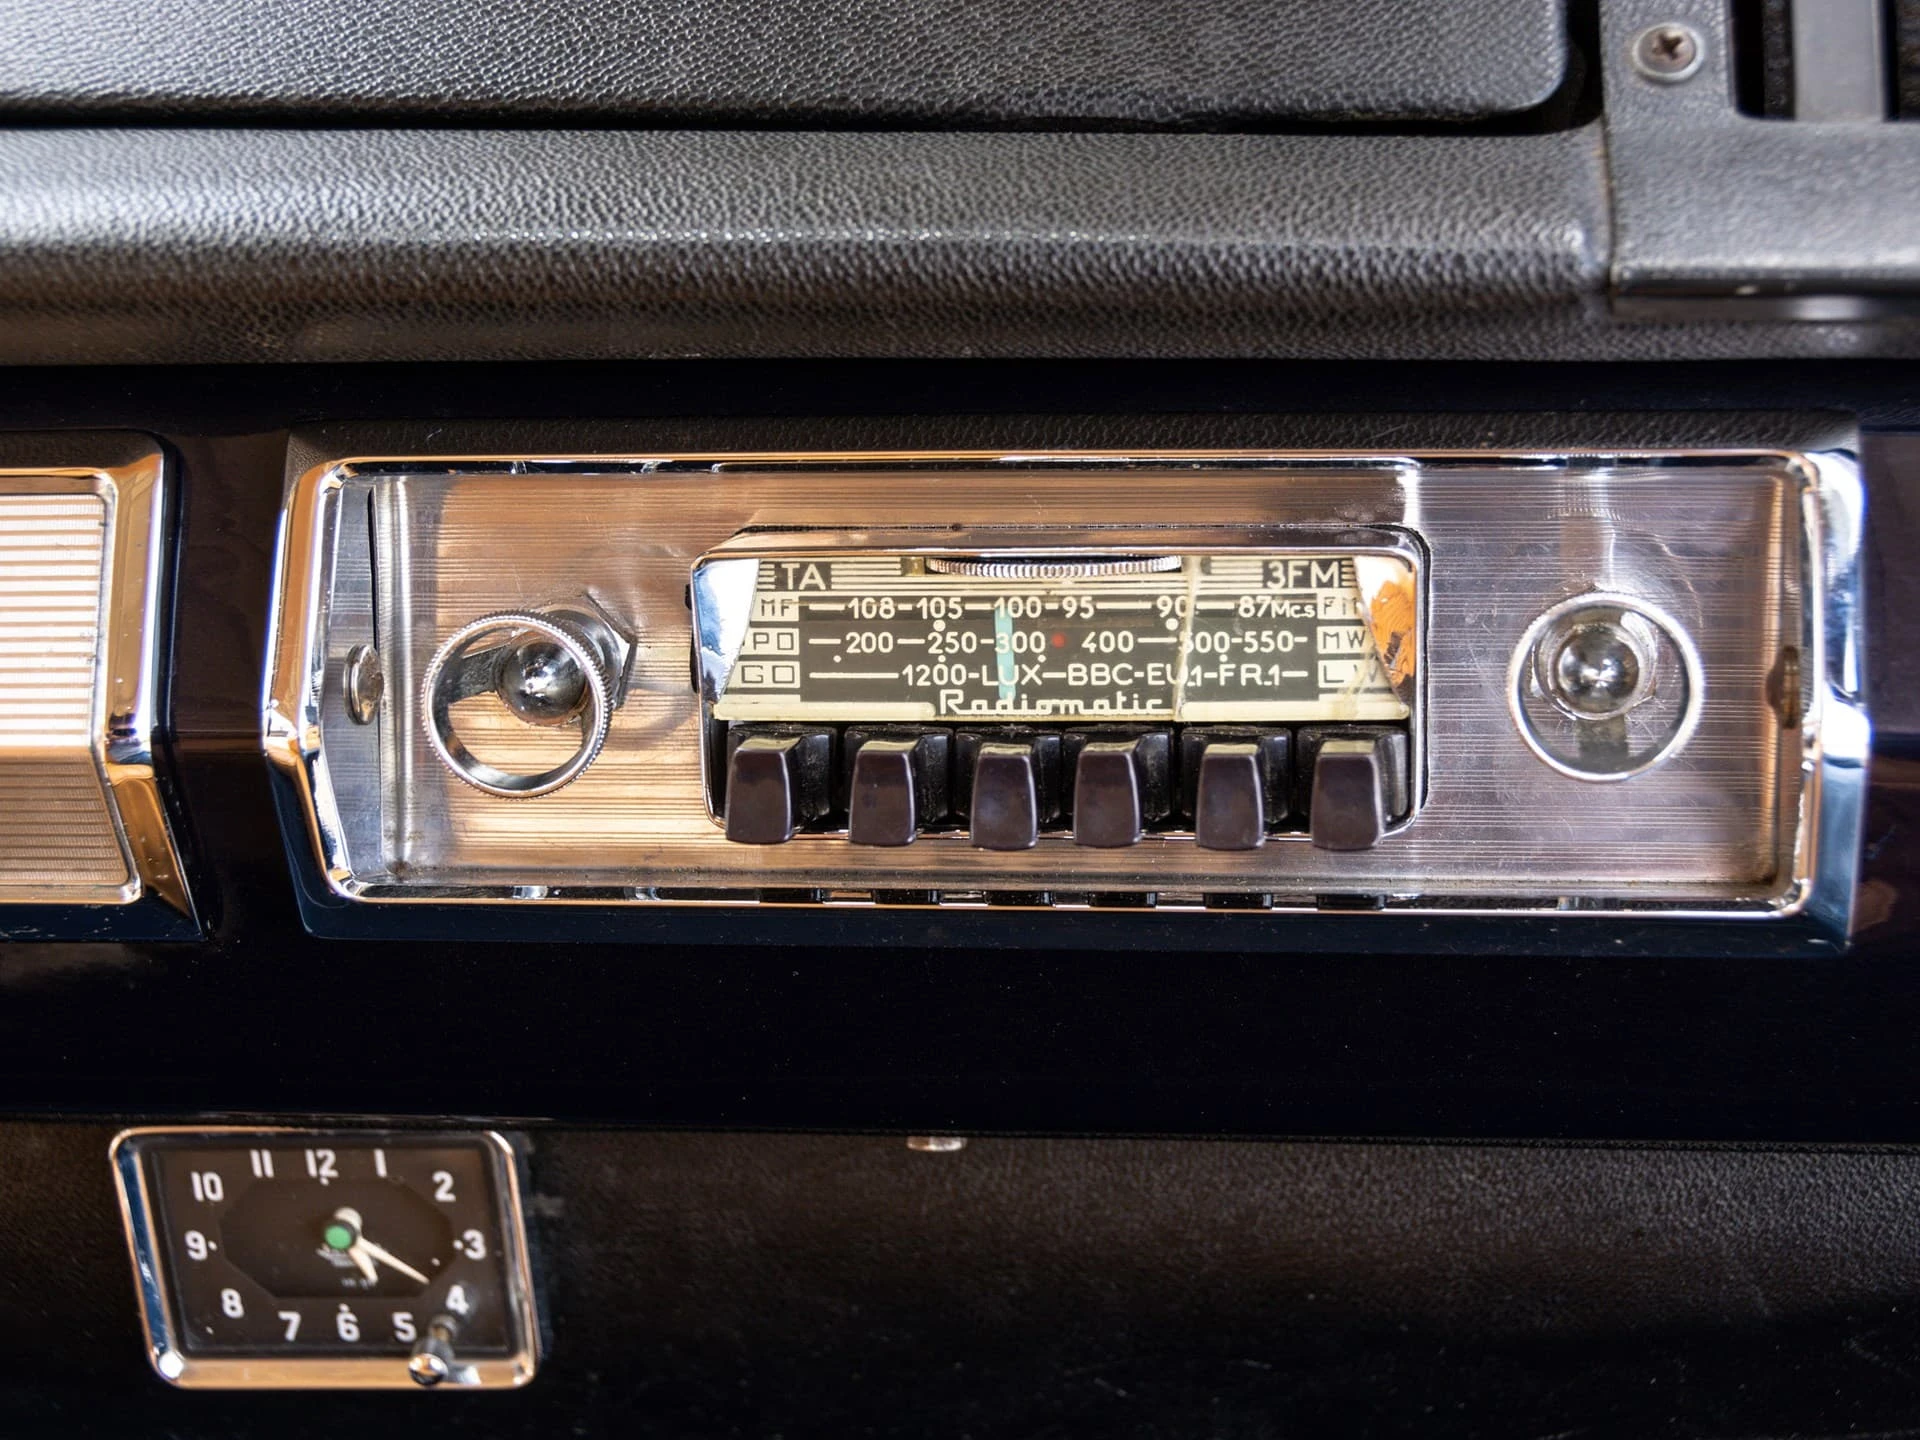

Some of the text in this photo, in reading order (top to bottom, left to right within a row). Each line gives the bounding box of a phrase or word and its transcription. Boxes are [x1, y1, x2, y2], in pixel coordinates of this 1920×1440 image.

[781, 562, 827, 590] TA
[761, 598, 793, 616] MF
[849, 597, 895, 619] 108
[917, 597, 963, 619] 105
[994, 597, 1042, 619] 100
[1062, 596, 1095, 619] 95
[1156, 595, 1189, 618] 90
[753, 632, 794, 650] PO
[845, 632, 894, 654] 200
[927, 632, 977, 654] 250
[994, 632, 1046, 654] 300
[1081, 631, 1134, 653] 400
[1243, 631, 1293, 653] 550
[1323, 629, 1366, 649] MW
[741, 665, 795, 683] GO
[902, 664, 967, 686] 1200
[982, 664, 1043, 686] LUX
[1067, 663, 1134, 686] BBC
[939, 689, 1174, 715] Radiomatic
[250, 1149, 274, 1178] 11
[305, 1149, 338, 1178] 12
[374, 1149, 388, 1178] 1
[191, 1171, 224, 1202] 10
[432, 1170, 457, 1202] 2
[185, 1230, 208, 1260] 9
[463, 1230, 486, 1260] 3
[220, 1288, 245, 1319] 8
[445, 1284, 470, 1314] 4
[278, 1311, 301, 1342] 7
[337, 1312, 360, 1342] 6
[392, 1312, 417, 1342] 5
